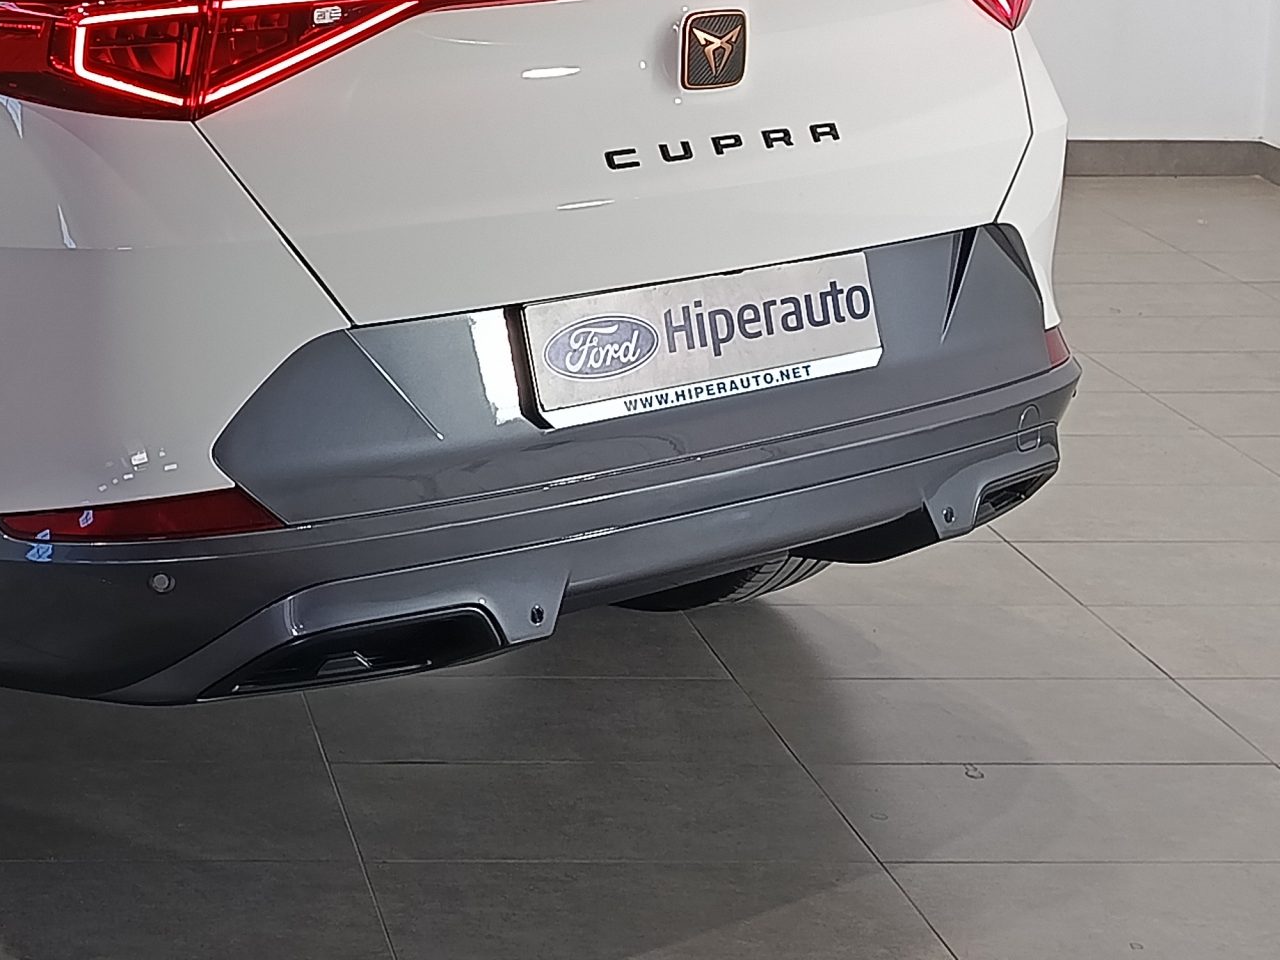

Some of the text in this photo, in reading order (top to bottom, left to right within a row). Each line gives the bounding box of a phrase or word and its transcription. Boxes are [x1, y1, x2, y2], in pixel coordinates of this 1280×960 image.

[604, 122, 841, 171] CUPRA
[663, 280, 871, 357] Hiperauto
[564, 323, 641, 374] Ford
[623, 365, 812, 412] WWW.HIPERAUTO.NET
